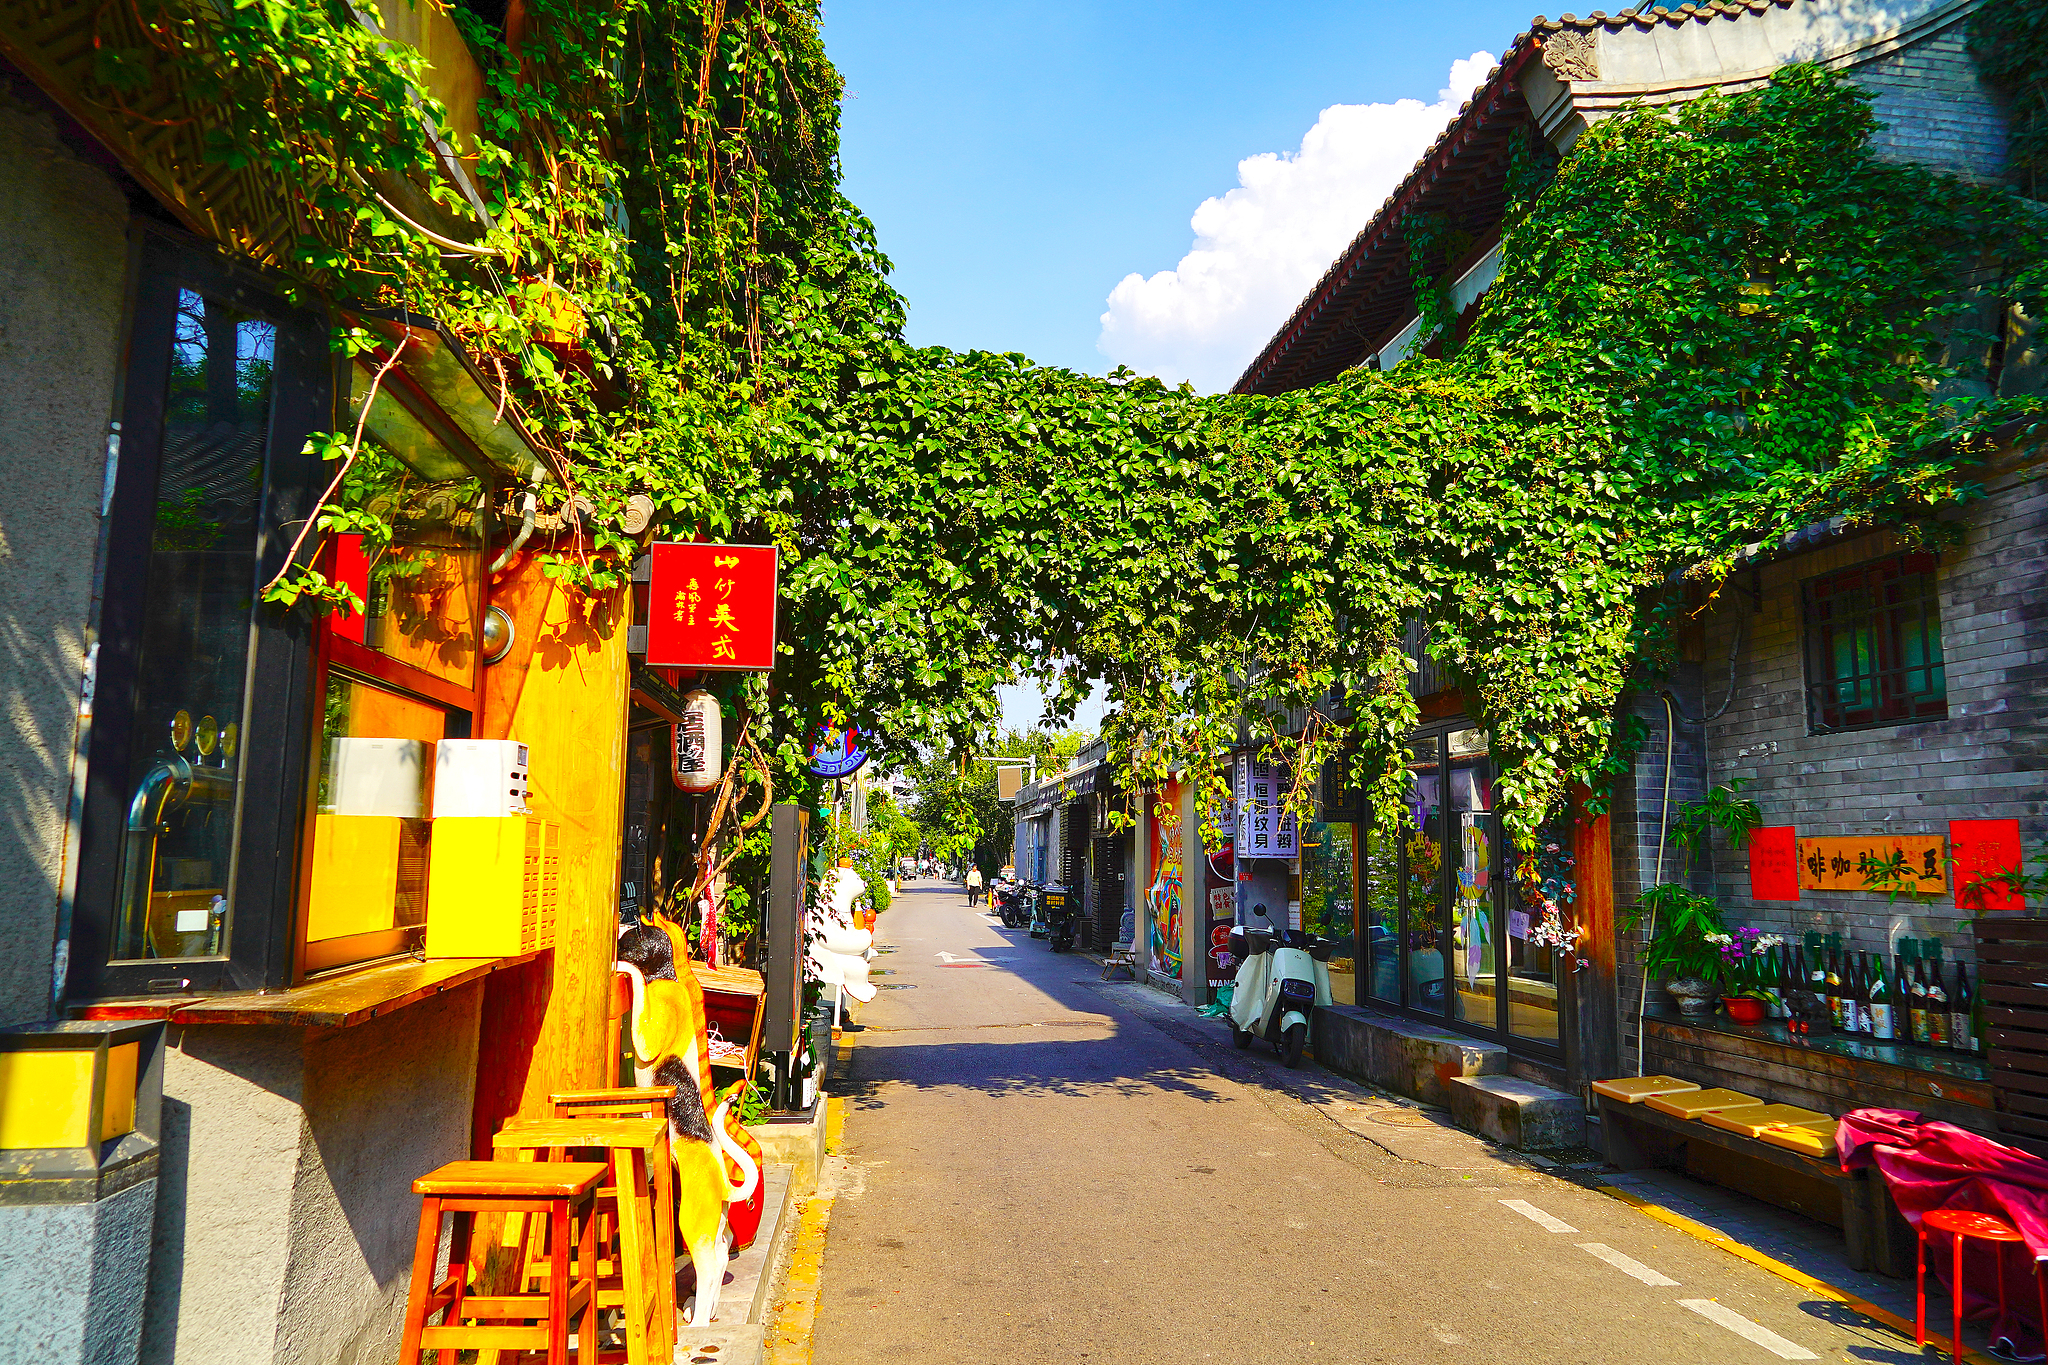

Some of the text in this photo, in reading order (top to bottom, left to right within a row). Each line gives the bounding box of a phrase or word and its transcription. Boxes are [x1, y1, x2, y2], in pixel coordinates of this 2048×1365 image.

[708, 555, 740, 660] 山竹美式
[677, 710, 706, 773] 居酒屋
